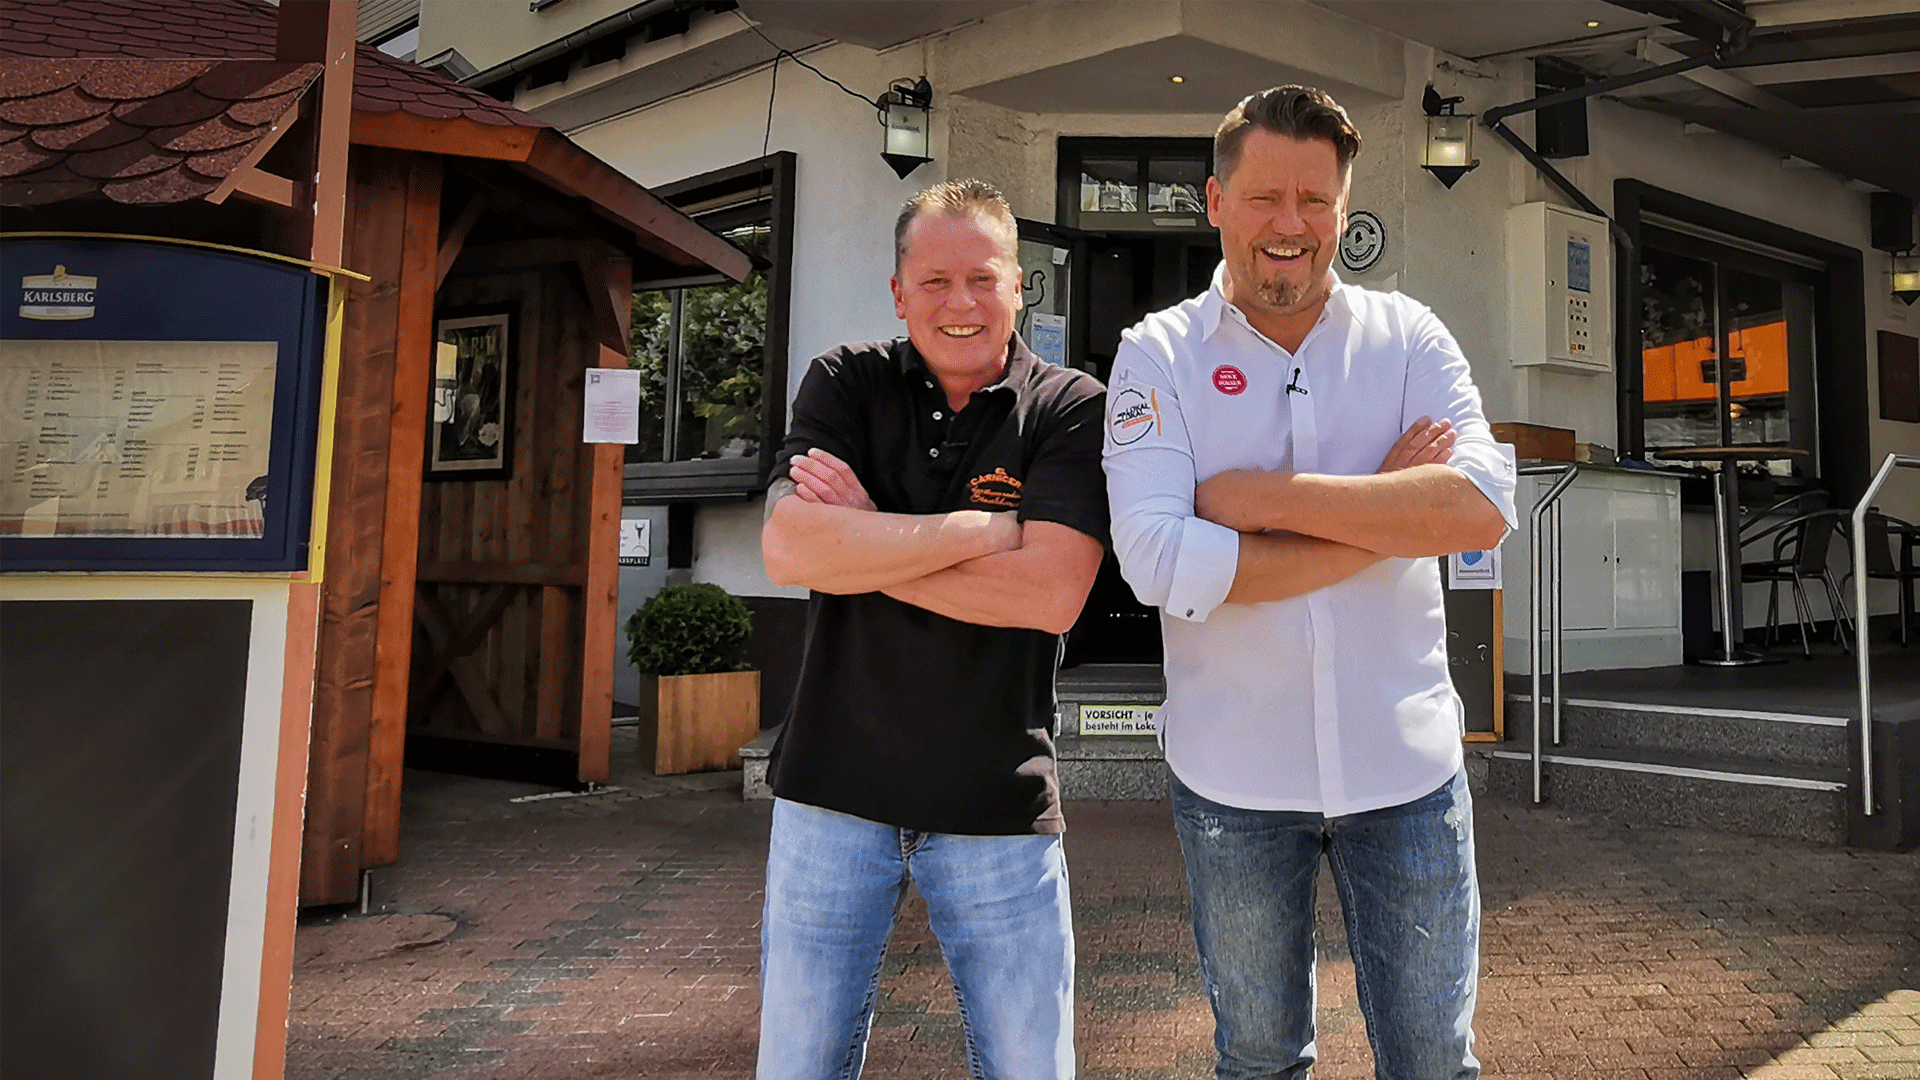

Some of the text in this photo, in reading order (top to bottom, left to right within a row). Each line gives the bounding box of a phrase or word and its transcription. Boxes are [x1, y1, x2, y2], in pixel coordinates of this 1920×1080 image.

[24, 290, 94, 303] KARLSBERG
[1085, 710, 1134, 720] VORSICHT
[1085, 721, 1119, 731] besteht
